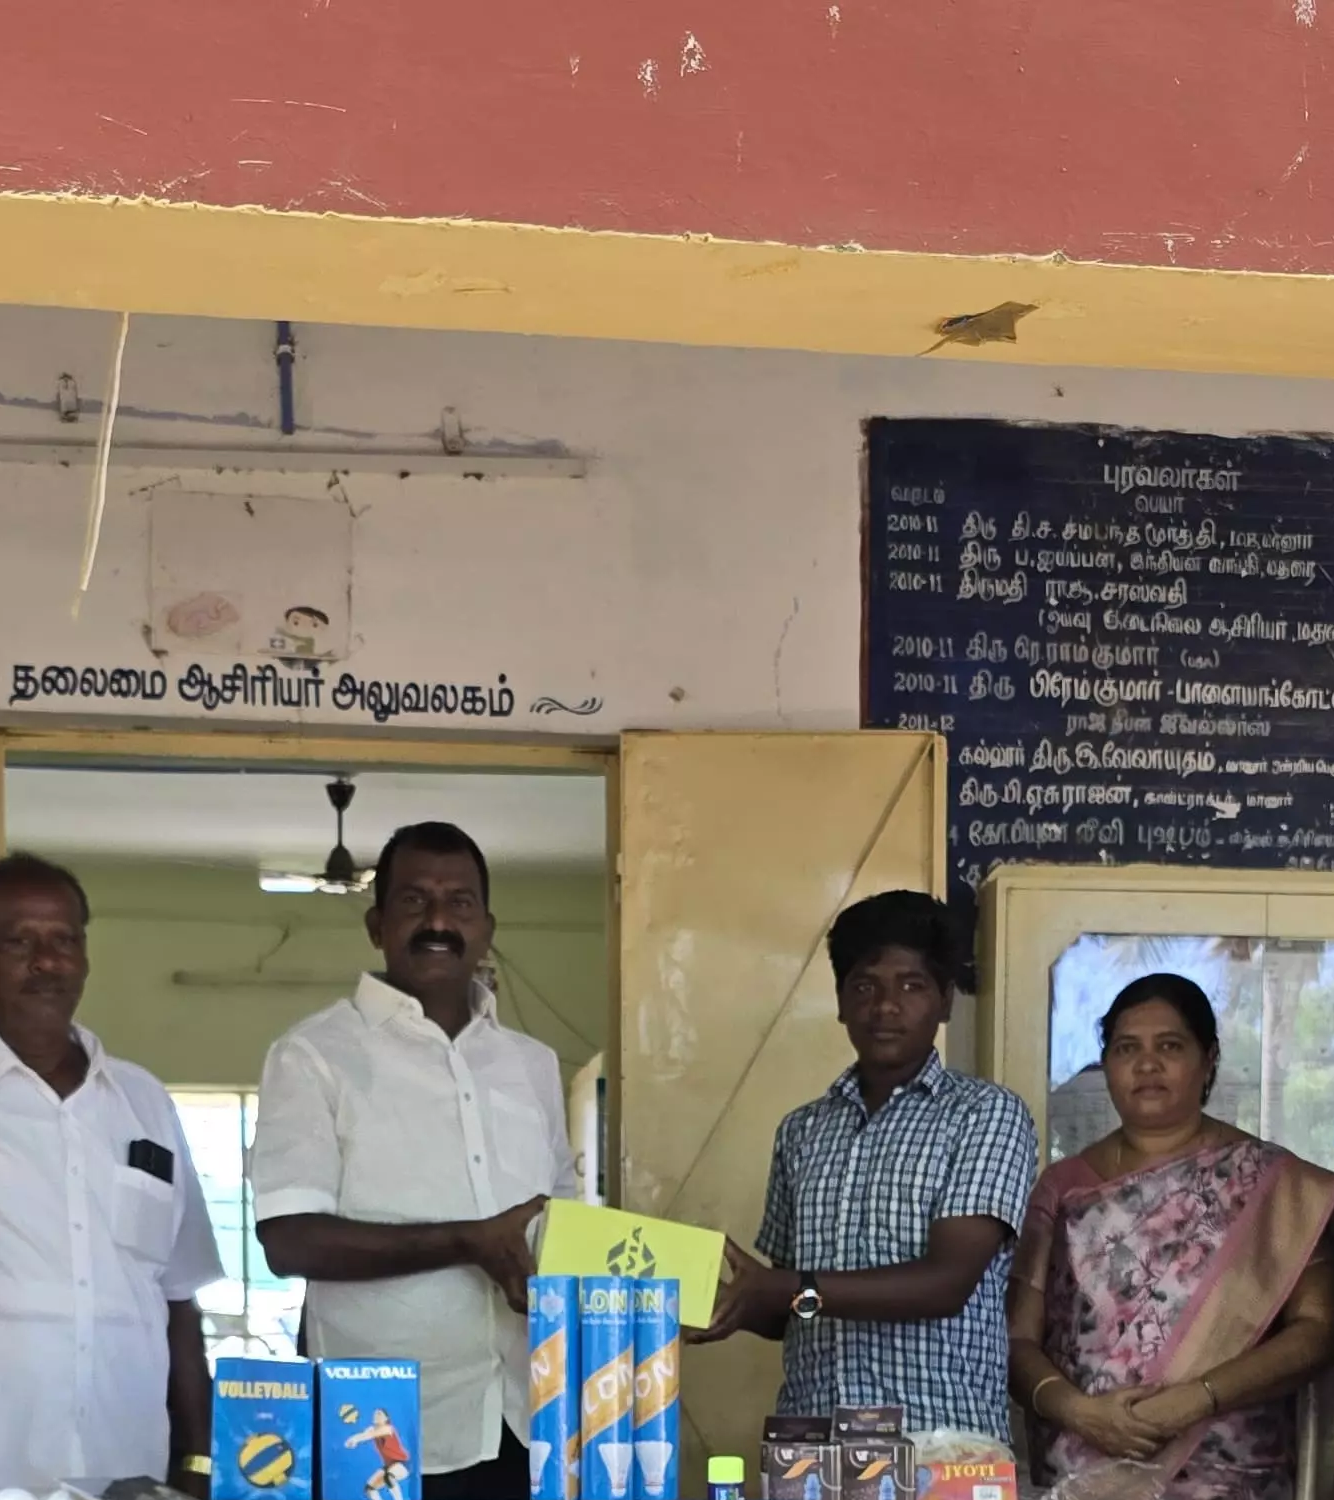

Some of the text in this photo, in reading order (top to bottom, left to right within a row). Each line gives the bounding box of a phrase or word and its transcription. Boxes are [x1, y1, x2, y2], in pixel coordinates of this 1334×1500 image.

[1103, 460, 1243, 494] புரவலர்கள்
[886, 514, 939, 533] 2010-11
[958, 511, 998, 541] திரு
[887, 543, 941, 563] 2010-11
[957, 540, 1002, 571] திரு
[888, 572, 943, 593] 2010-11
[956, 566, 1028, 606] திருமதி
[891, 634, 954, 659] 2010-11
[965, 631, 1009, 664] திரு
[8, 661, 515, 723] தலைமை ஆசிரியர் அலுவலகம்
[892, 671, 959, 695] 2010-11
[967, 668, 1016, 701] திரு
[1028, 668, 1164, 708] பிரேம்குமார்
[324, 1366, 417, 1380] VOLLEYBALL
[218, 1380, 309, 1399] VOLLEYBALL
[942, 1464, 996, 1480] JYOTI
